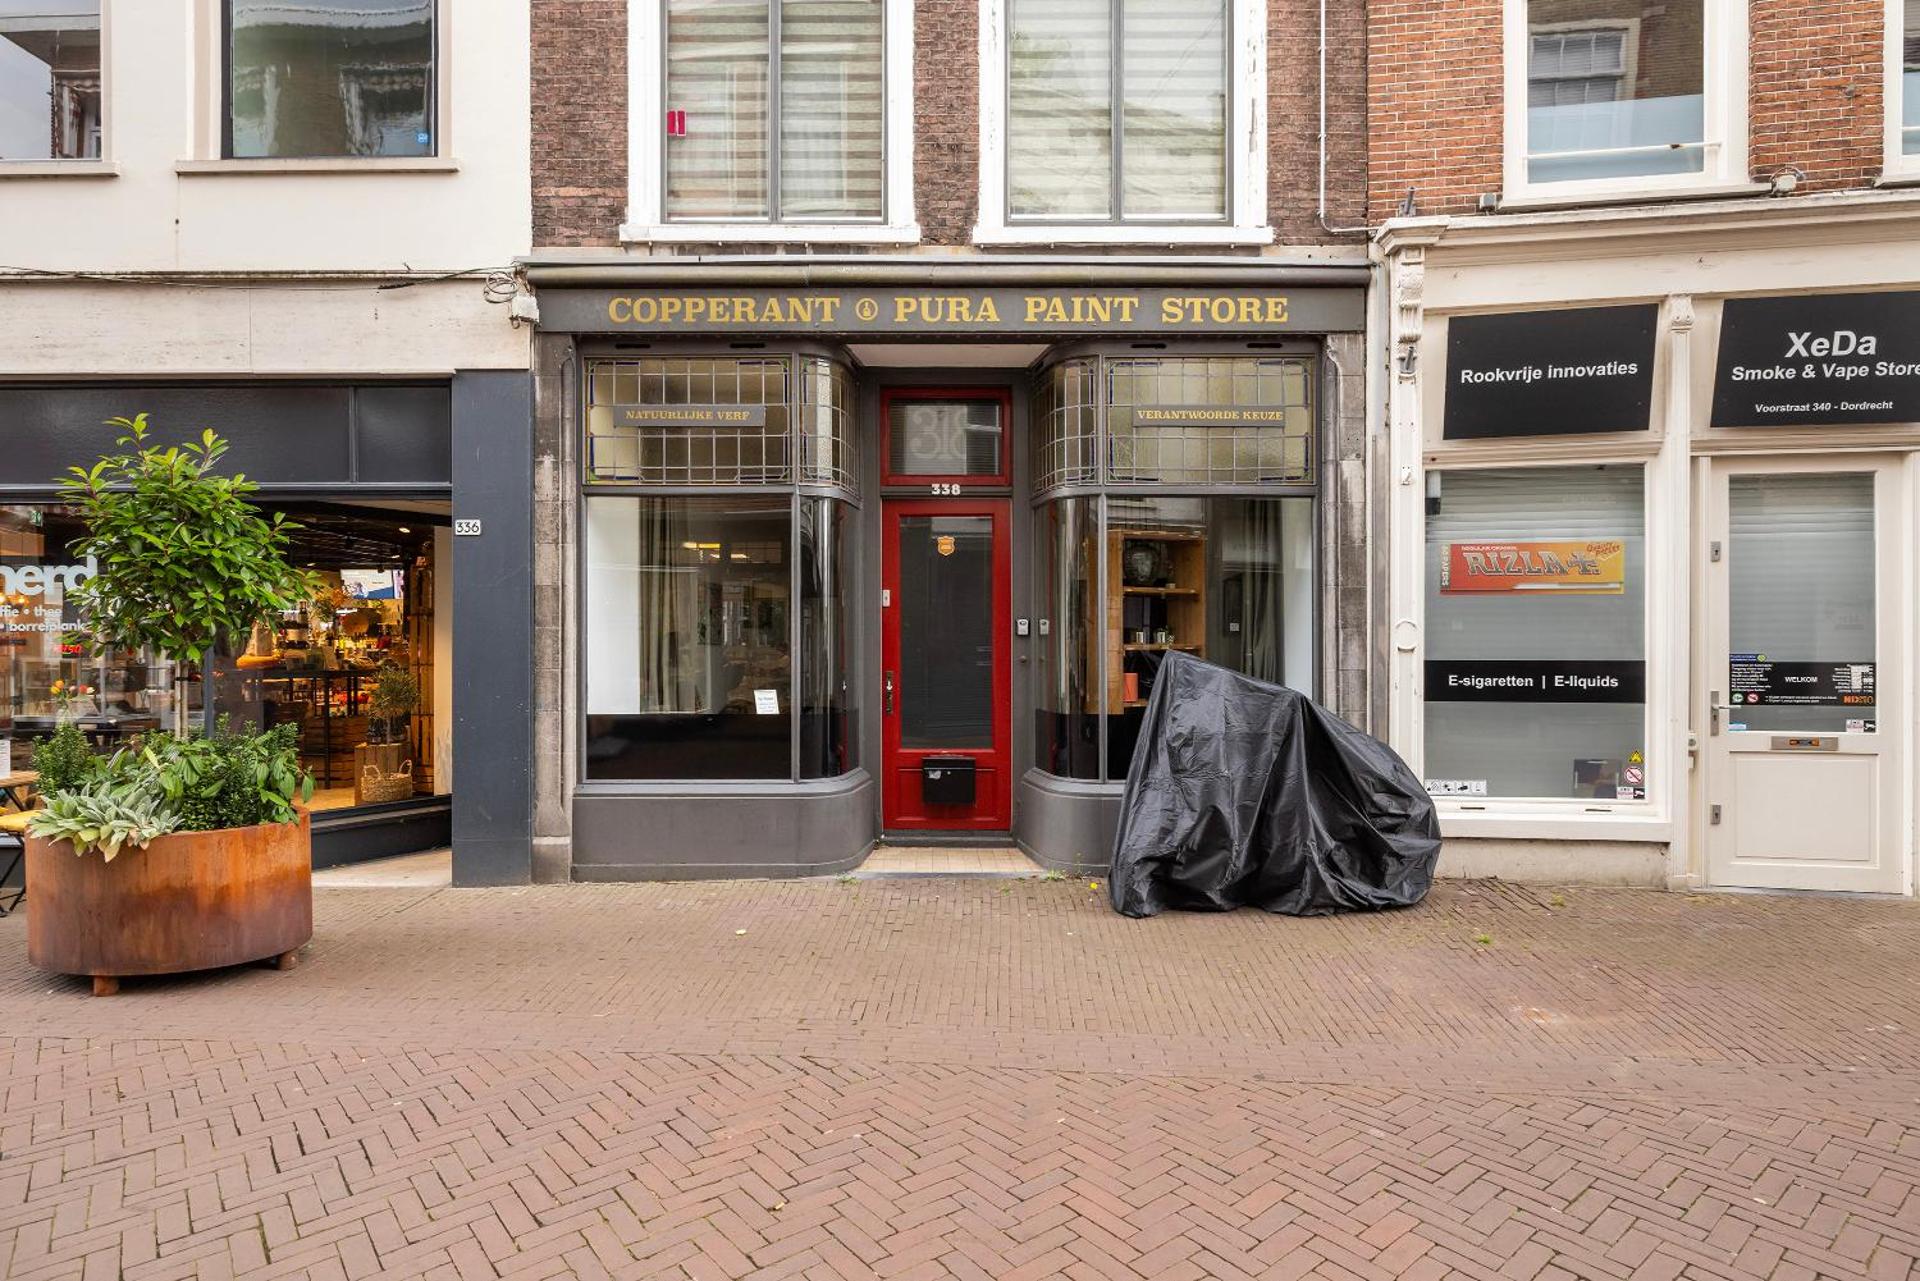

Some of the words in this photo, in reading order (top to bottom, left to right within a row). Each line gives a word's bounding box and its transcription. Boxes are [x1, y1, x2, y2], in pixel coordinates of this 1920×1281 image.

[608, 296, 840, 323] COPPERANT
[894, 297, 1000, 323] PURA
[1024, 297, 1139, 323] PAINT
[1161, 297, 1288, 323] STORE
[1784, 330, 1877, 358] XeDa
[1461, 366, 1542, 383] Rookvrije
[1548, 361, 1638, 379] innovaties
[1732, 365, 1796, 381] Smoke
[1802, 364, 1816, 378] &
[1822, 363, 1869, 380] Vape
[1755, 403, 1810, 413] Voorstraat
[1813, 402, 1831, 411] 340
[1841, 401, 1893, 411] Dordrecht
[625, 410, 713, 420] NATUURLIJKE
[717, 411, 750, 421] VERF
[1137, 410, 1240, 420] VERANTWOORDE
[1243, 411, 1283, 421] KEUZE
[931, 483, 961, 495] 338
[456, 521, 480, 533] 336
[1448, 675, 1534, 689] E-sigaretten
[1554, 675, 1619, 690] E-liquids
